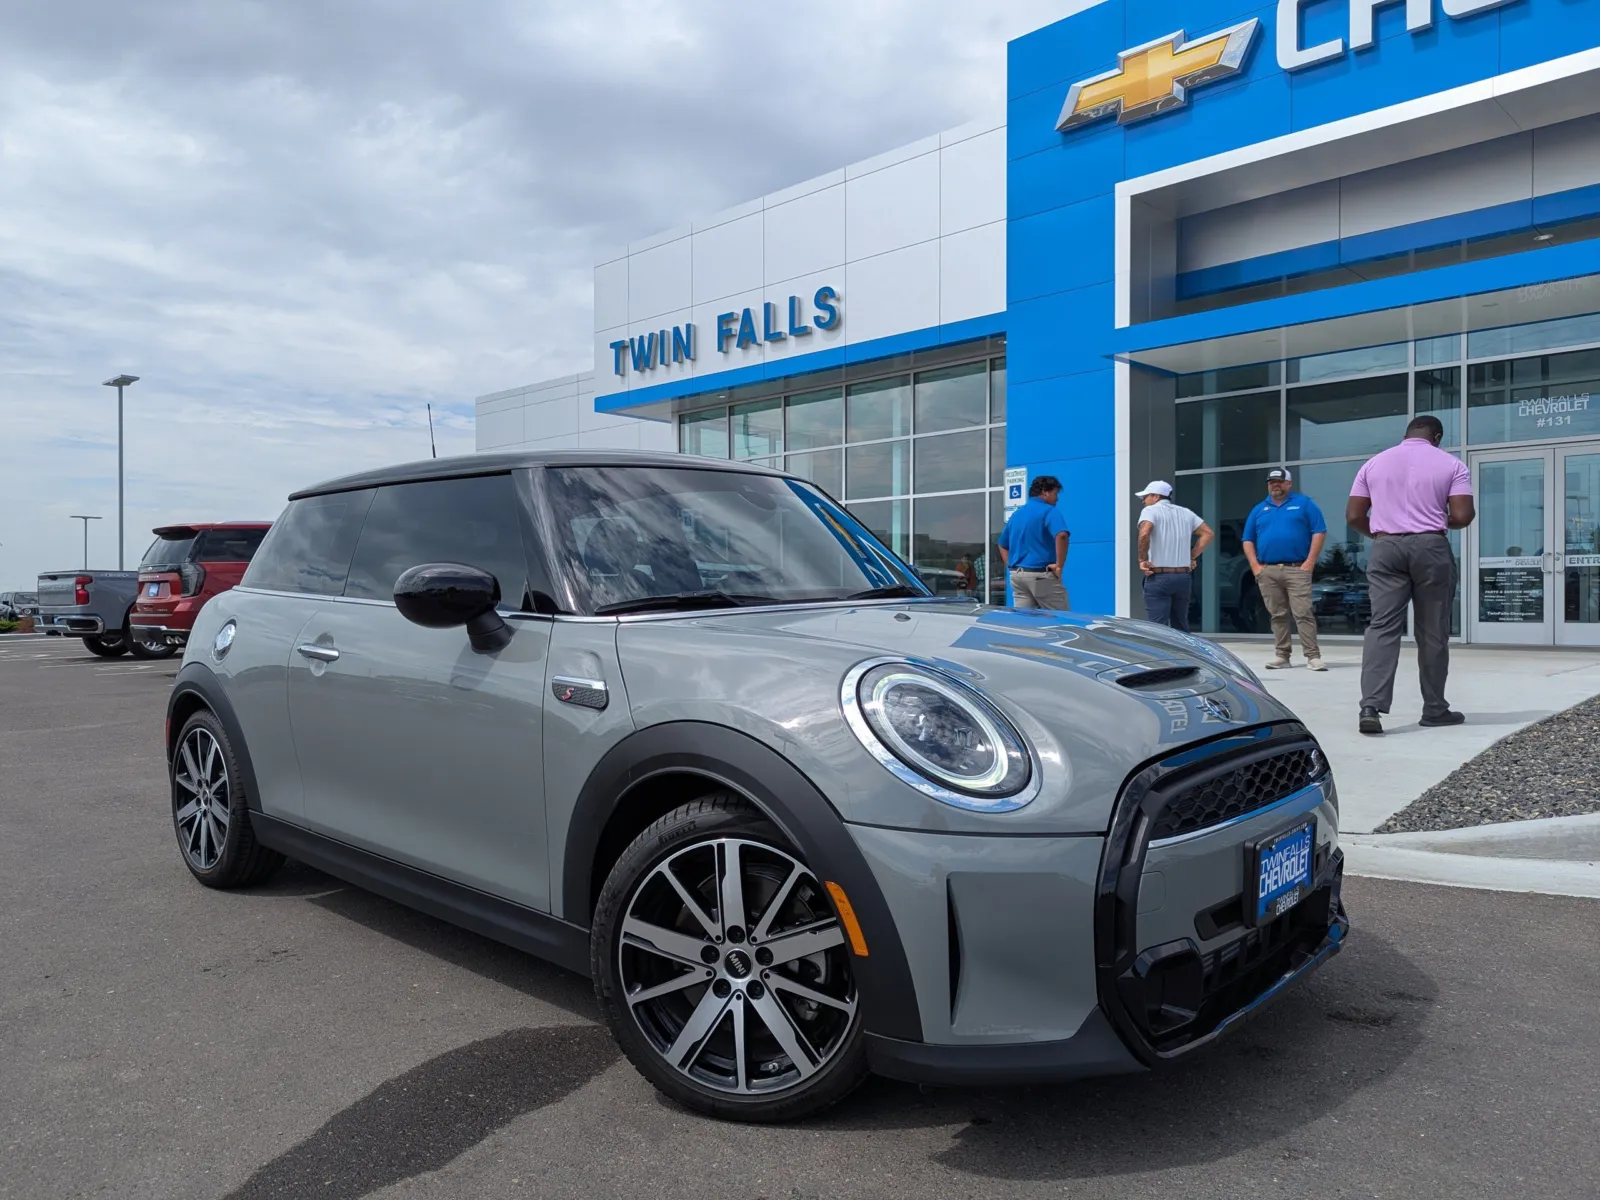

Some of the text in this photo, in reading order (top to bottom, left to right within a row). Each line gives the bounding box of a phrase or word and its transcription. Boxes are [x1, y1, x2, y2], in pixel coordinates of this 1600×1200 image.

[610, 286, 841, 376] TWIN FALLS
[1519, 399, 1589, 416] CHEVROLET
[1537, 415, 1571, 428] #131
[1259, 848, 1310, 898] CHEVROLET
[729, 953, 747, 975] MINI
